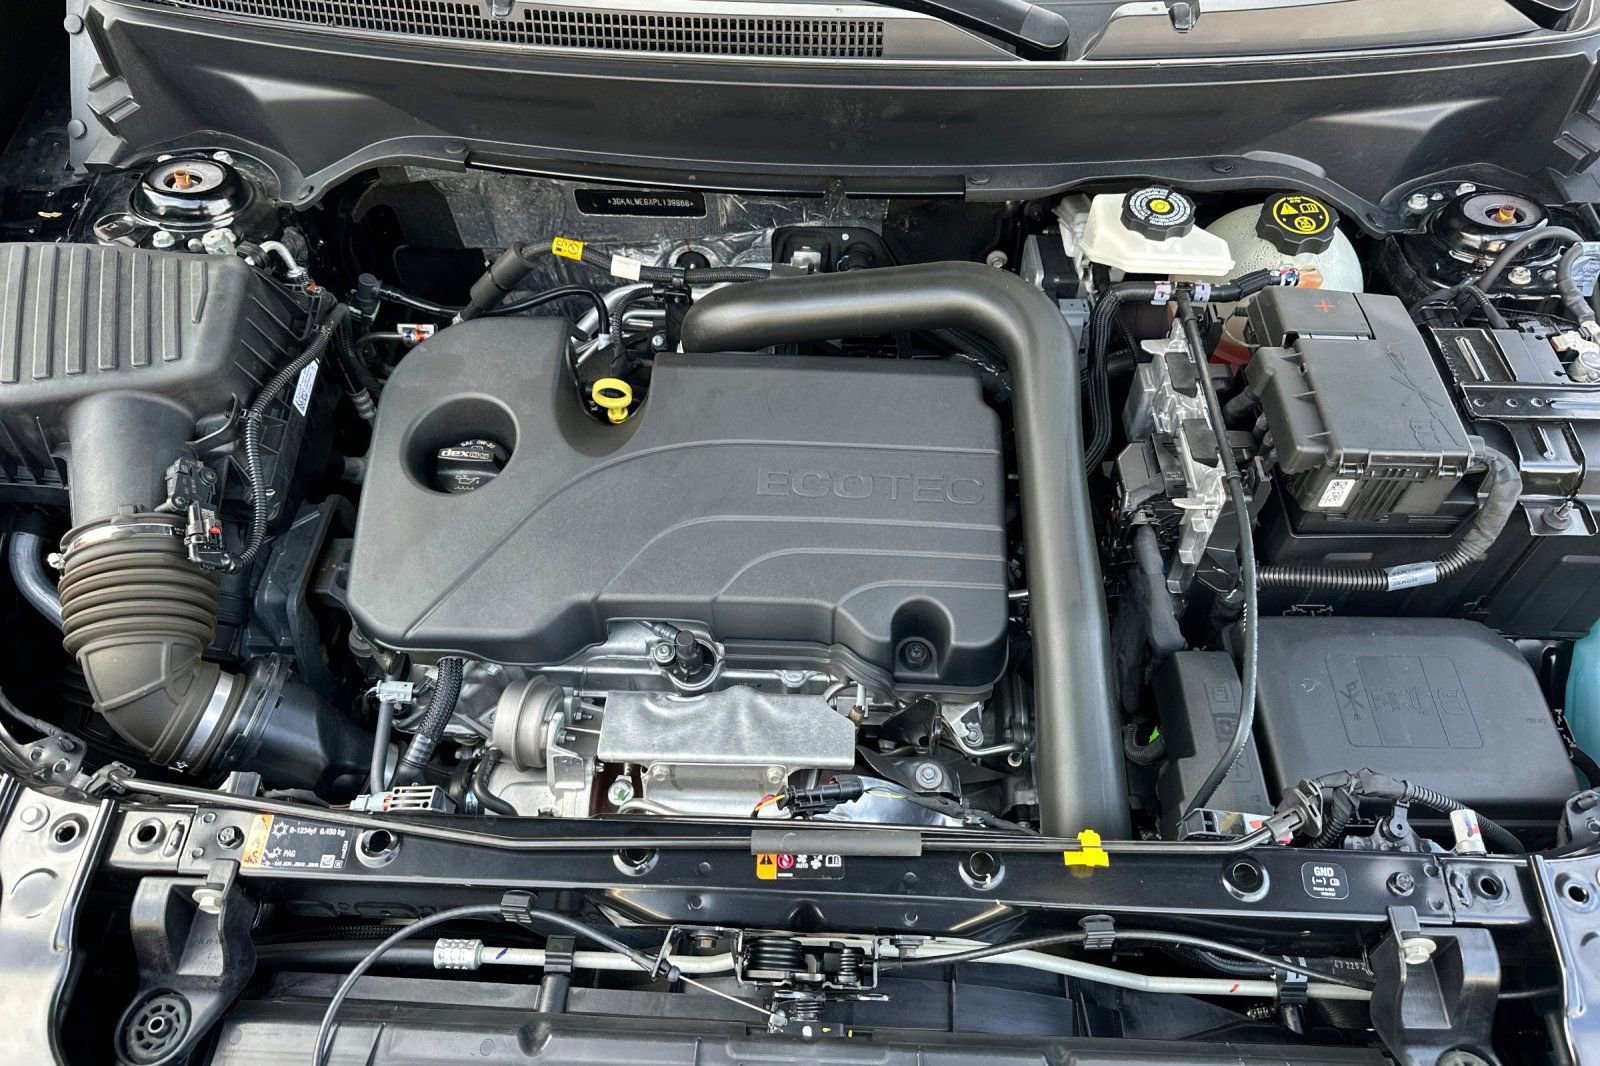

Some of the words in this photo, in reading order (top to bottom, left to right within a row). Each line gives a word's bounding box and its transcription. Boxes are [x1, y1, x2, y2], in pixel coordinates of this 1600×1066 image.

[756, 467, 985, 505] ECOTEC
[283, 850, 296, 858] PAG
[1313, 866, 1334, 877] GND
